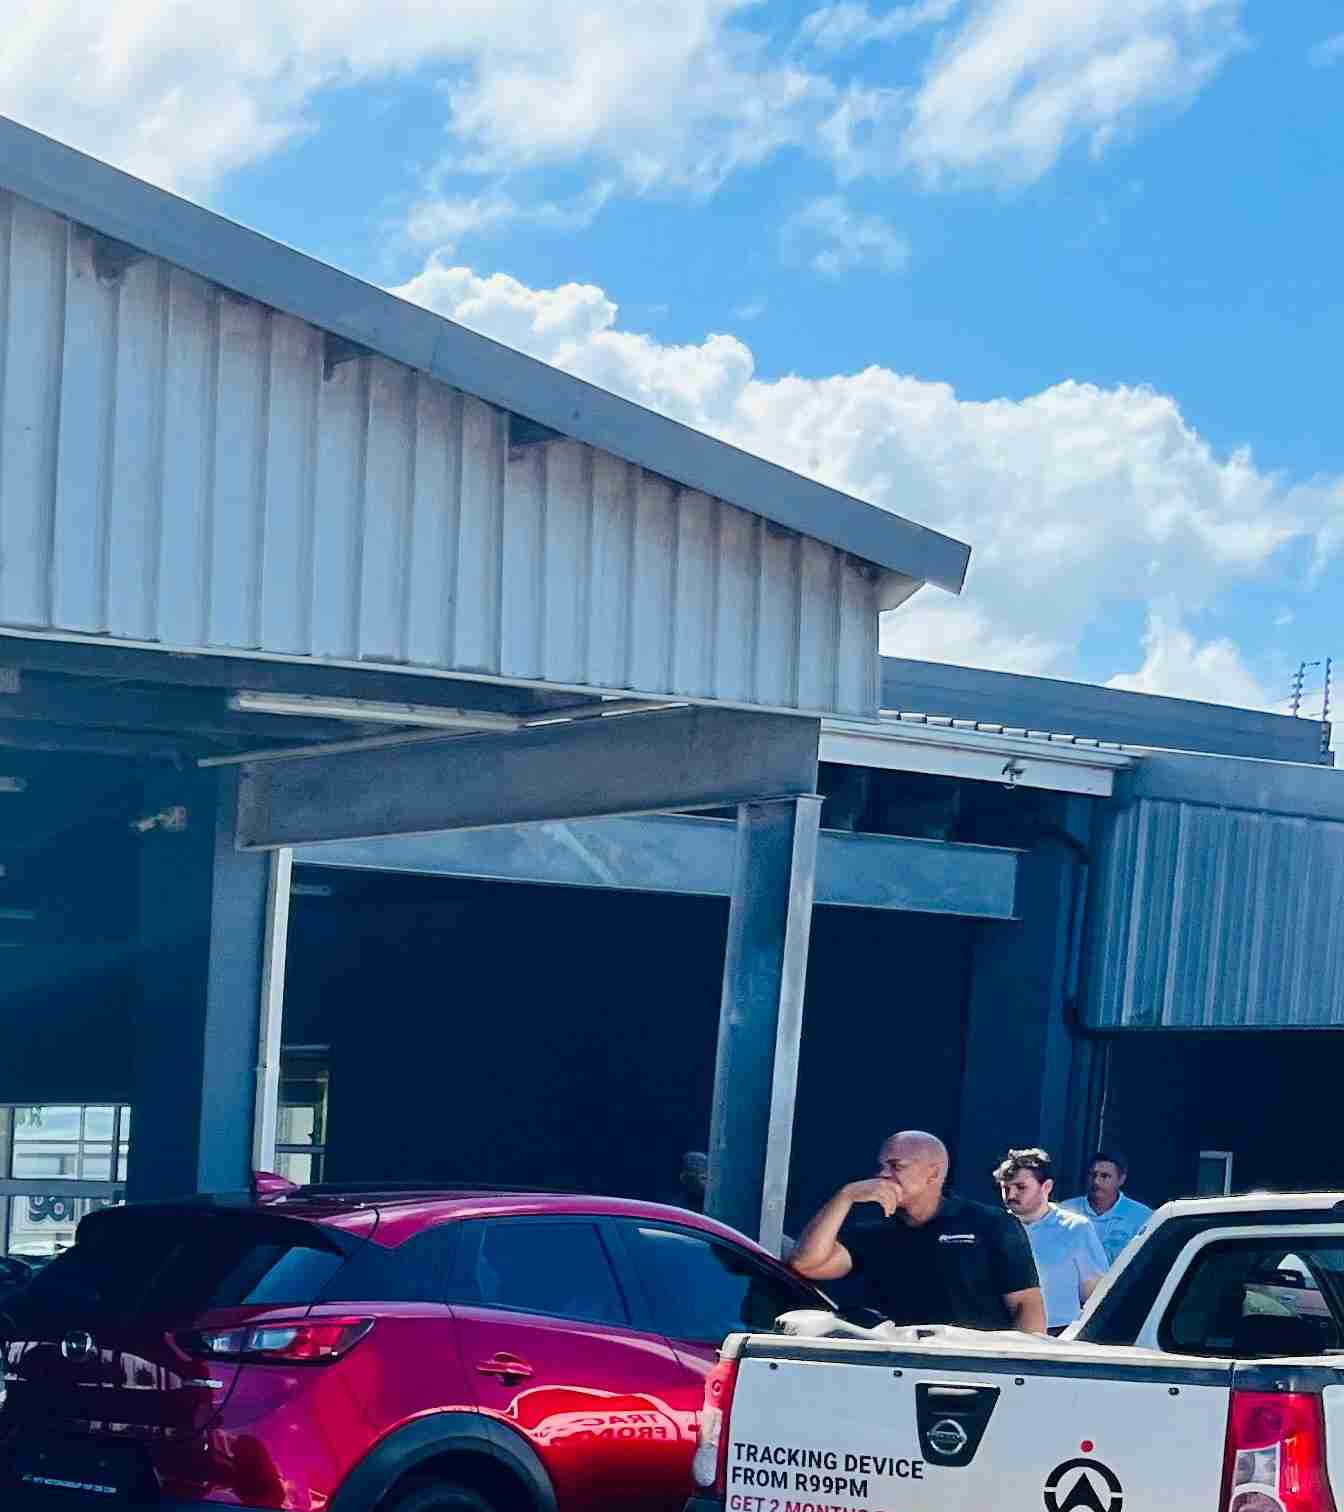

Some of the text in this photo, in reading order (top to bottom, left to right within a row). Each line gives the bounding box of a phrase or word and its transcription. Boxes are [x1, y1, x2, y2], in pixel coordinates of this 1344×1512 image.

[733, 1442, 925, 1480] TRACKING DEVICE
[731, 1466, 869, 1498] FROM R99PM
[729, 1494, 765, 1512] GET
